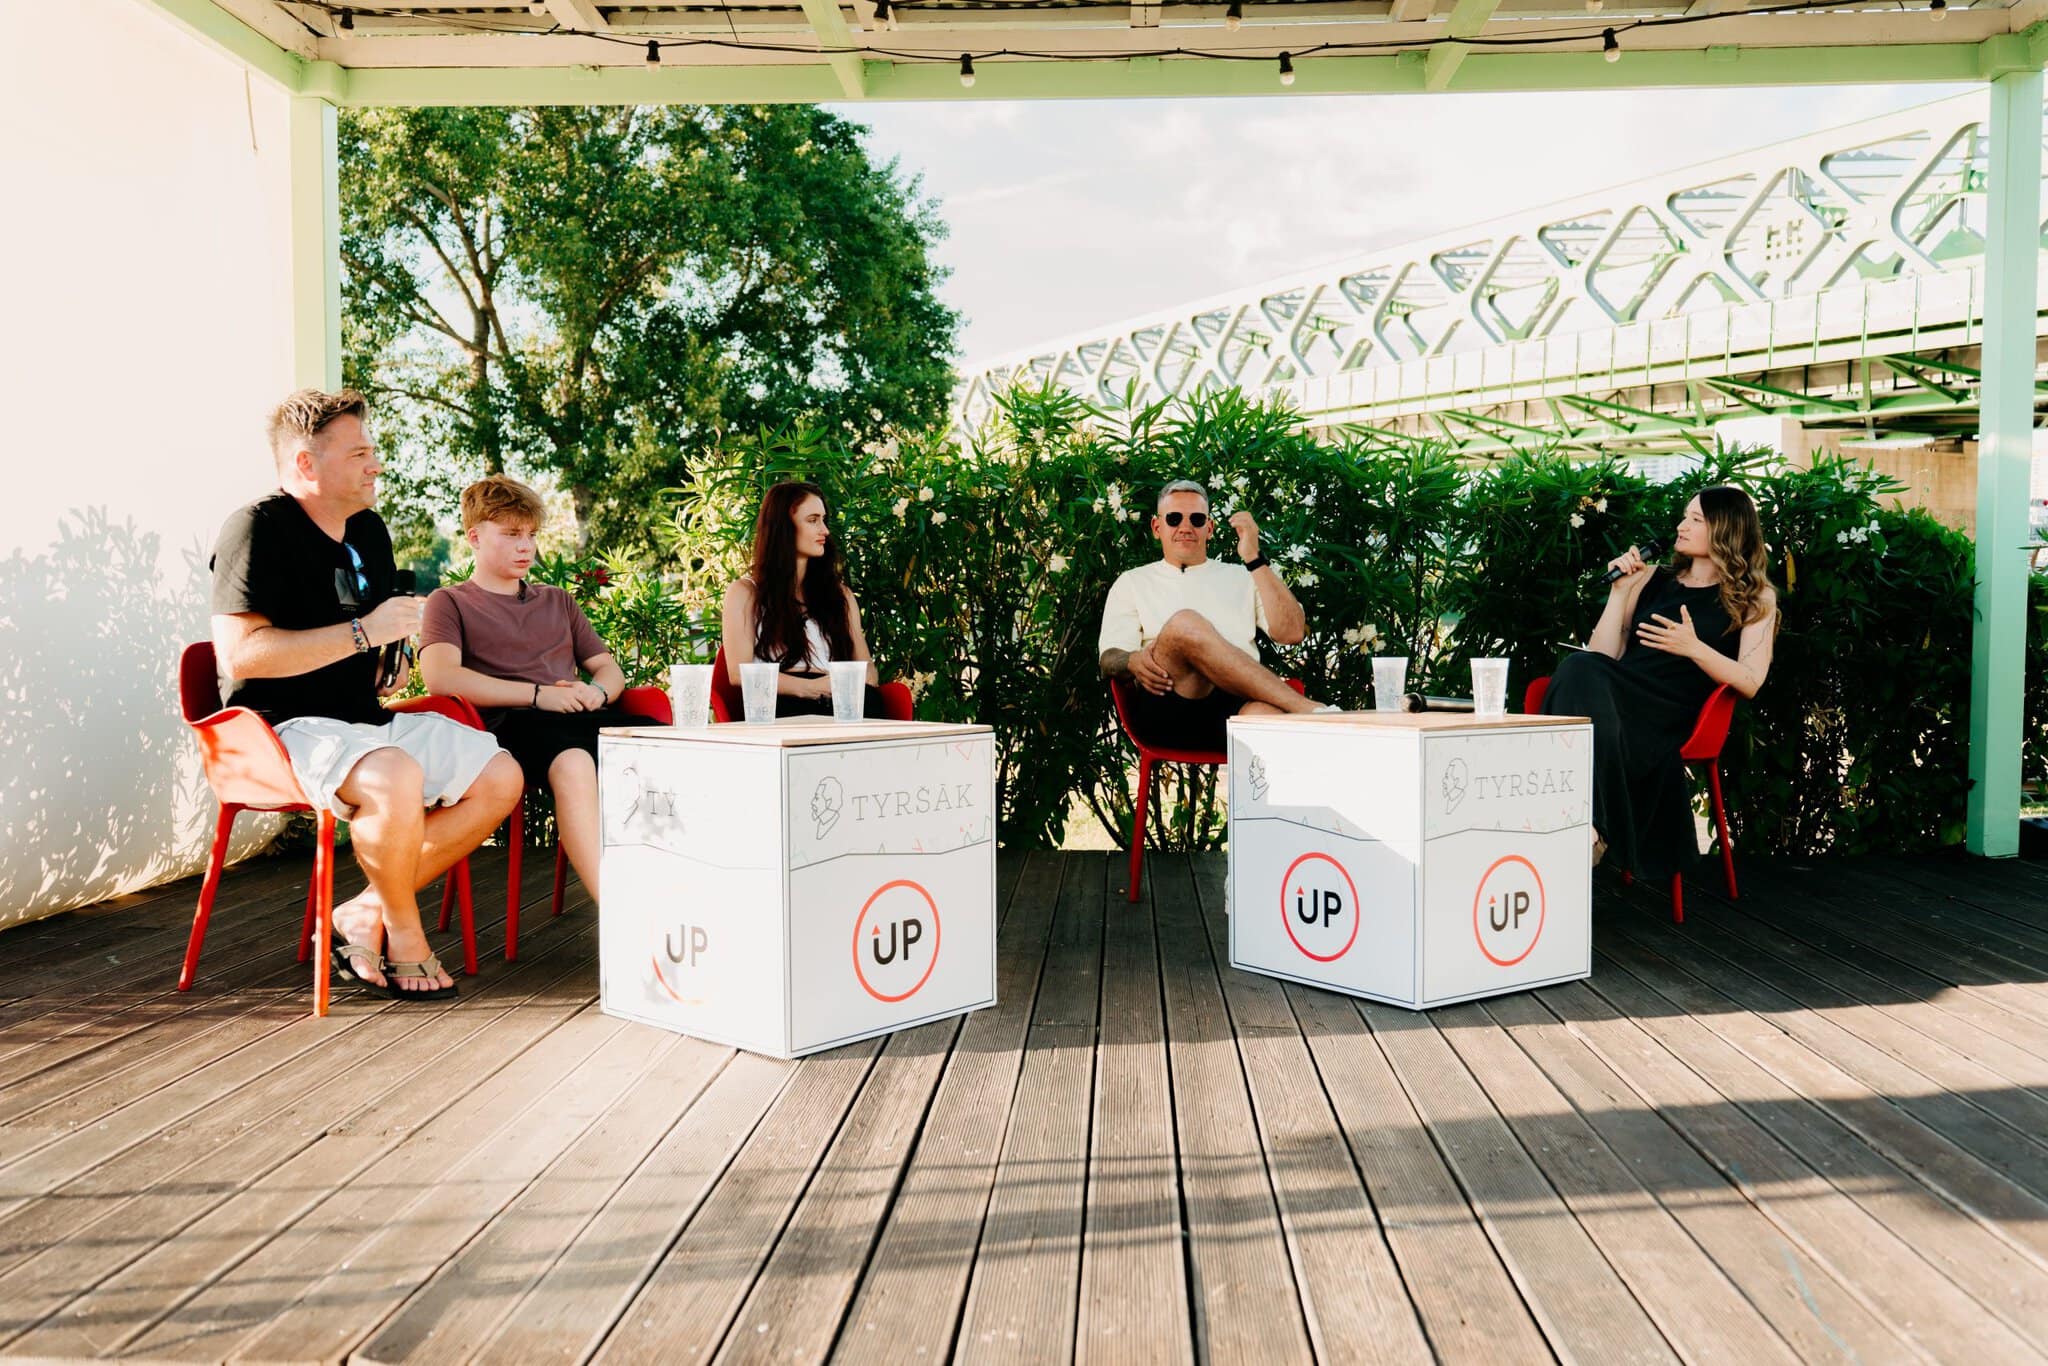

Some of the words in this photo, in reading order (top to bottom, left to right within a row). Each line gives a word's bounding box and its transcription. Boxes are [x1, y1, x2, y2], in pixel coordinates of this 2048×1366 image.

[1297, 889, 1342, 928] UP
[1490, 892, 1530, 932] UP
[666, 924, 708, 967] UP
[873, 919, 922, 966] UP
